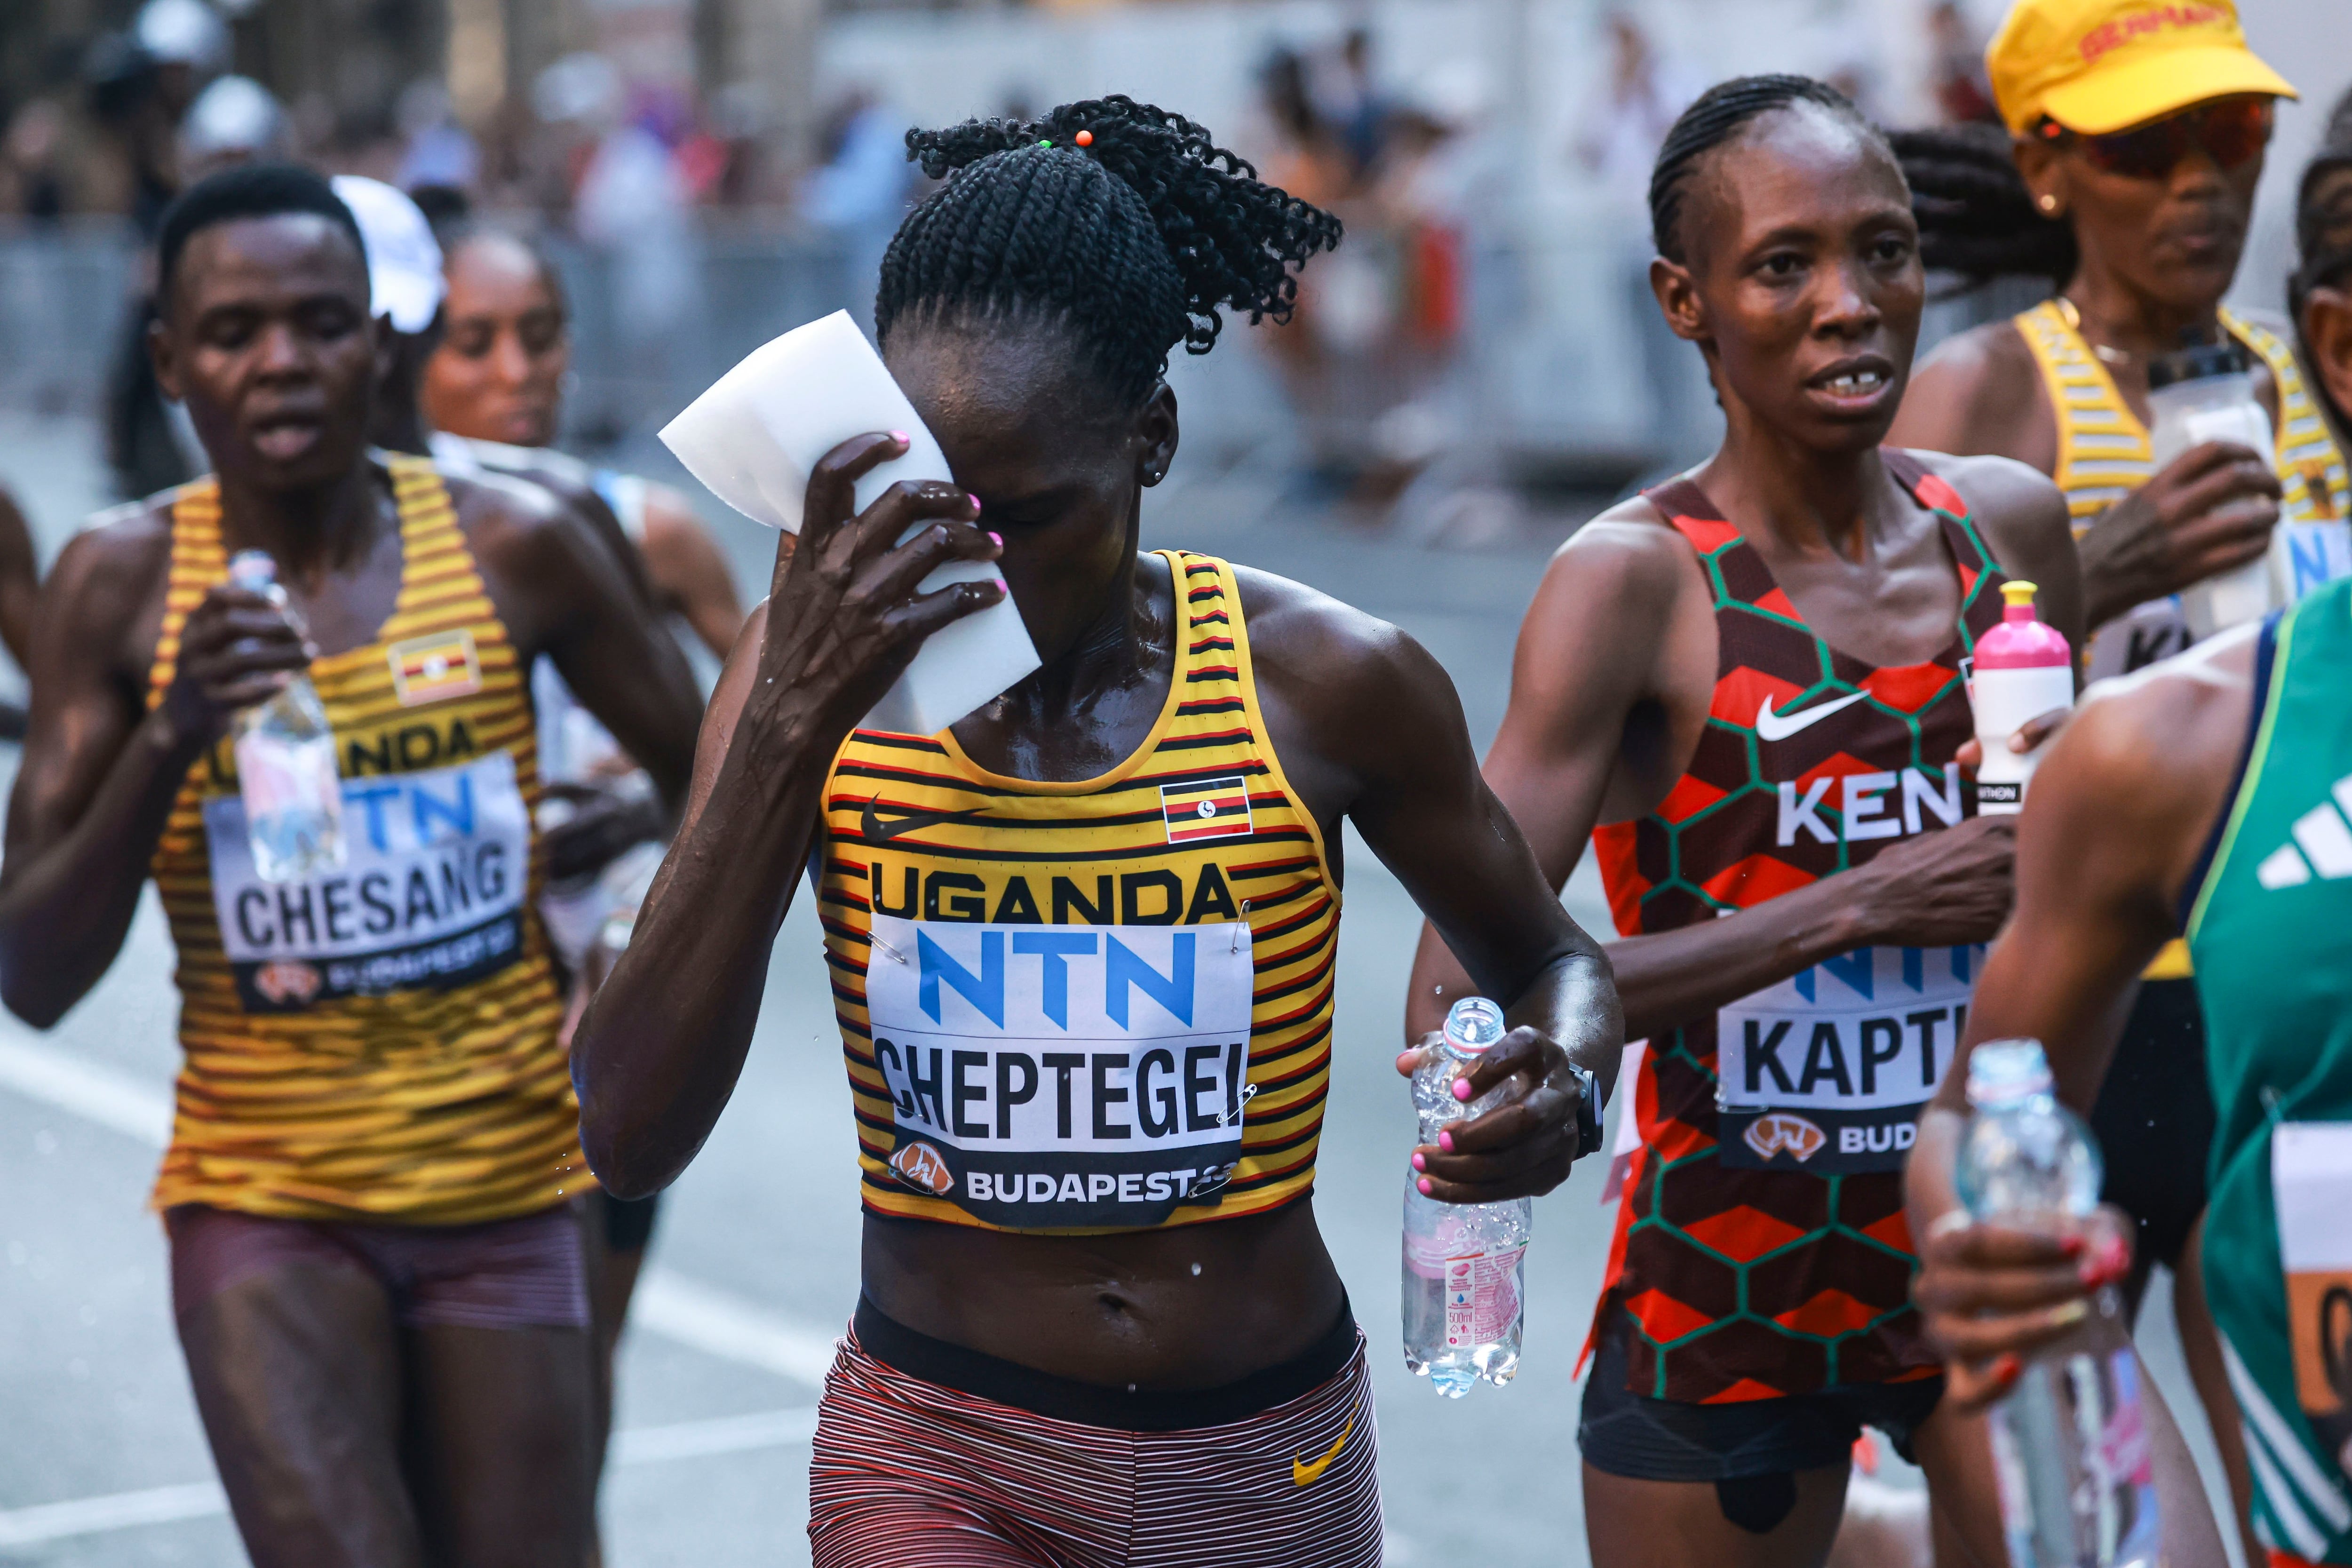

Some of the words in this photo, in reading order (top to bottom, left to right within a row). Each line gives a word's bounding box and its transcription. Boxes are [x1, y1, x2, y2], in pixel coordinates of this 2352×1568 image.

[210, 717, 476, 785] UNDA
[342, 772, 476, 851] TN
[1777, 762, 1963, 846] KEN
[236, 841, 506, 947] CHESANG
[871, 862, 1238, 925] UGANDA
[917, 927, 1196, 1031] NTN
[874, 1037, 1243, 1139] CHEPTEGEI
[1449, 1312, 1472, 1323] 500ml
